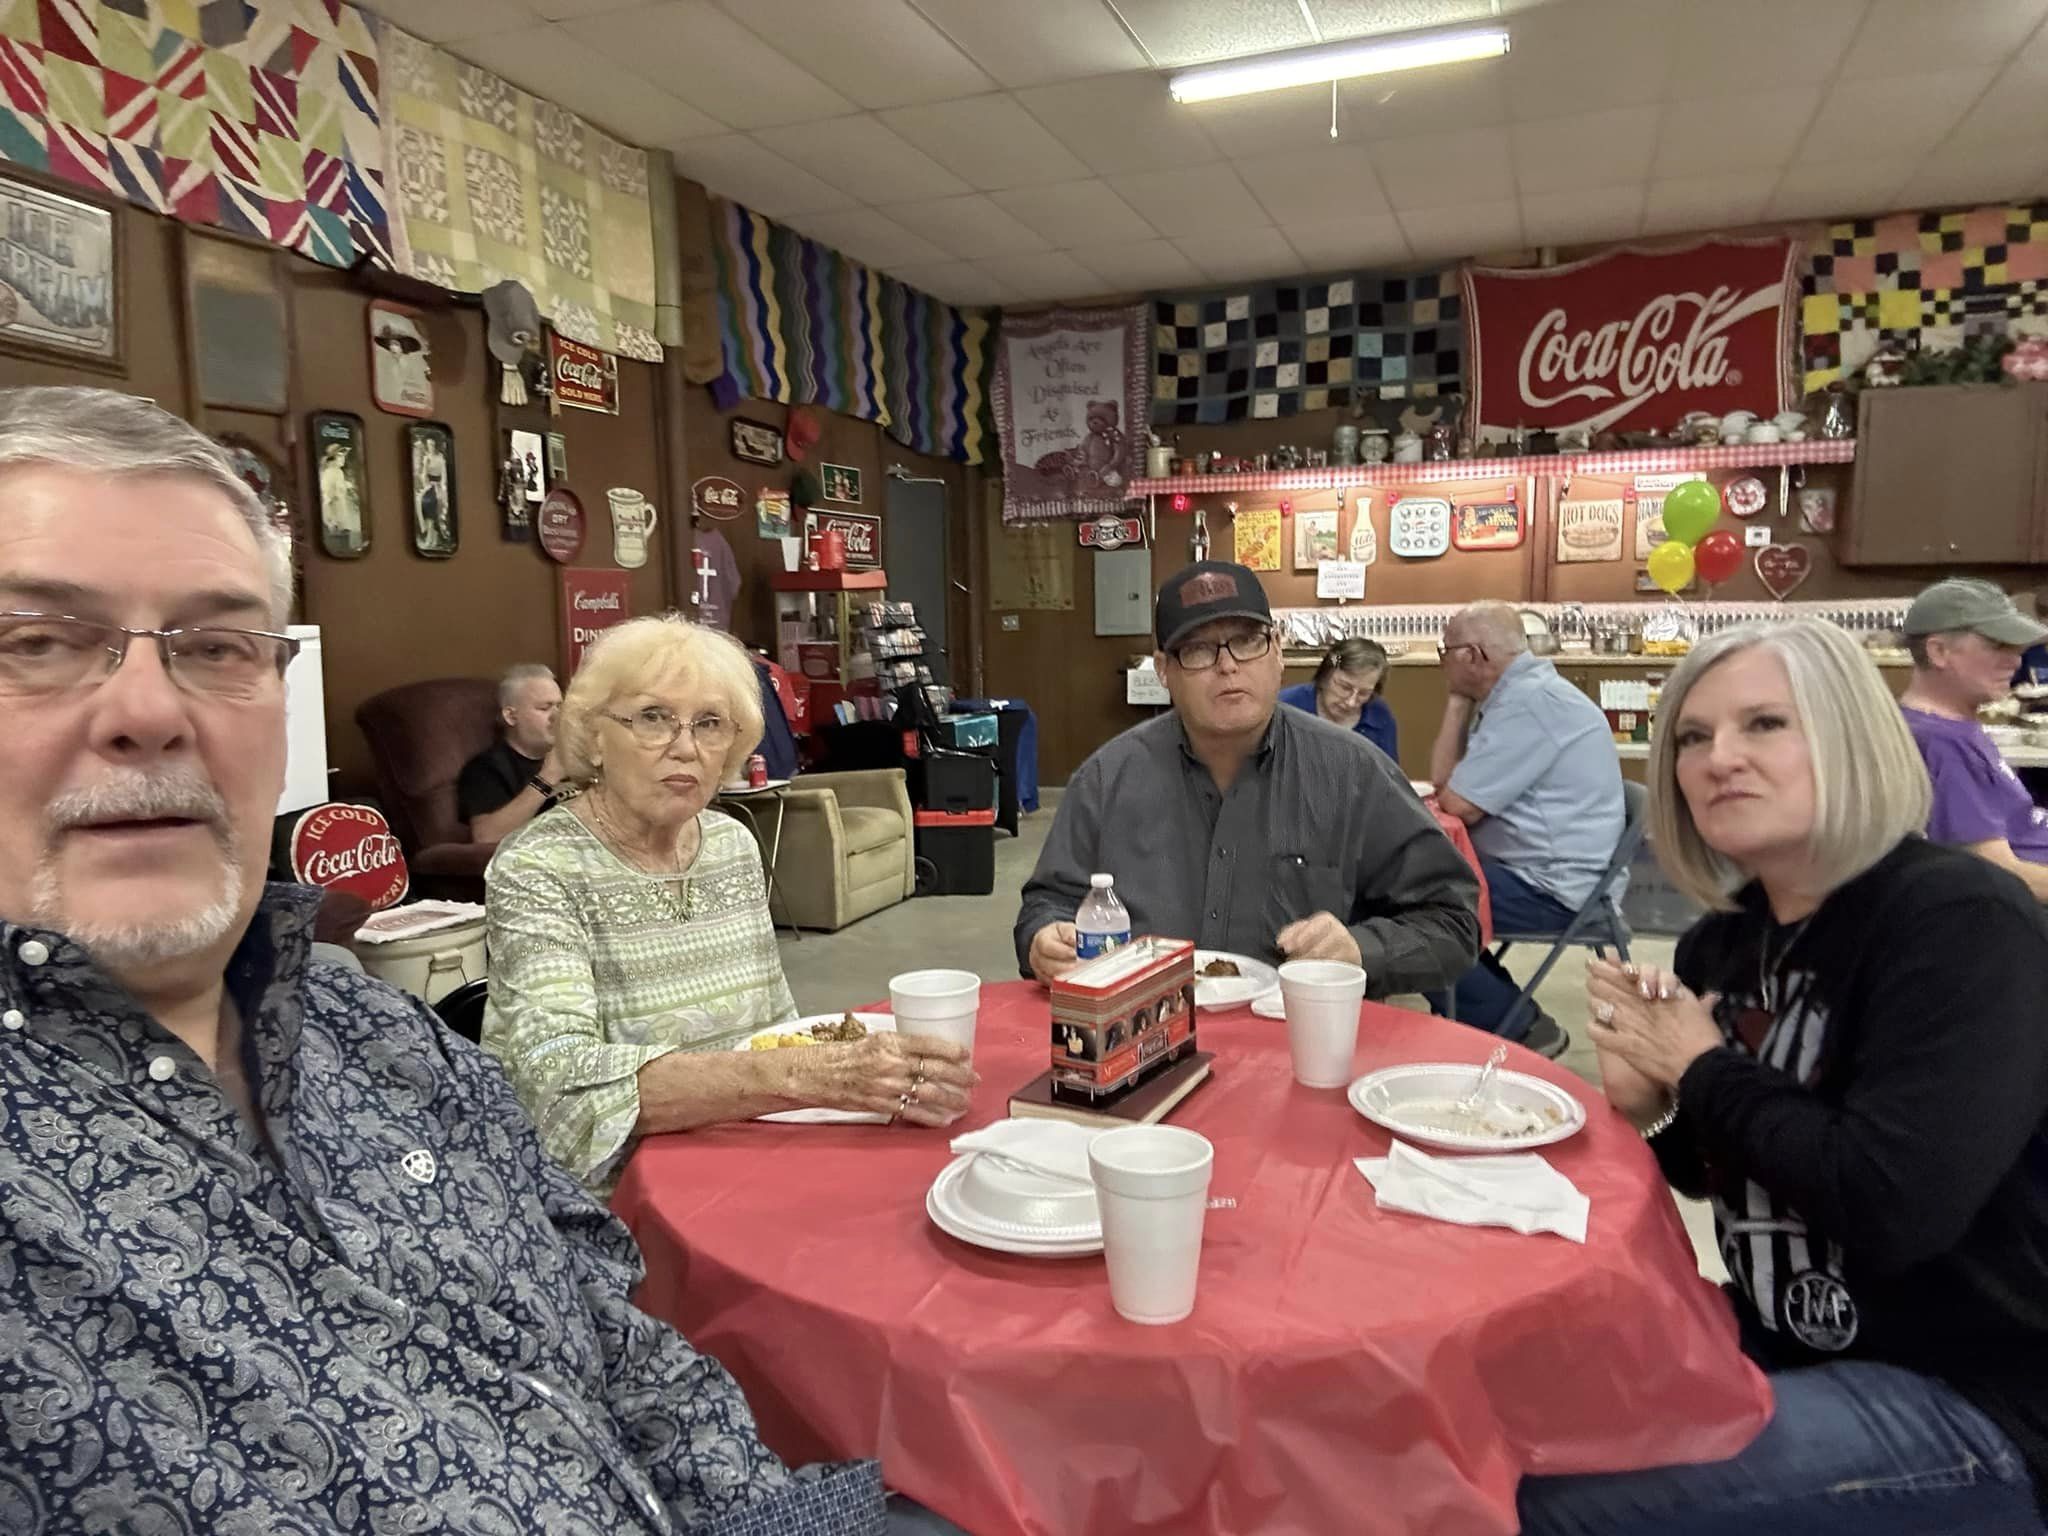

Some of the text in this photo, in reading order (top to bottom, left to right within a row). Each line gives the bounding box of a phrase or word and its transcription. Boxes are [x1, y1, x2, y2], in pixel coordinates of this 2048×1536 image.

[7, 201, 77, 268] ICE
[560, 339, 599, 362] ICE COLD
[560, 386, 583, 399] SOLD
[1030, 381, 1100, 404] Disguised
[1563, 503, 1620, 527] HOT DOGS
[305, 808, 379, 840] ICE COLD
[304, 832, 398, 887] Coca-Cola
